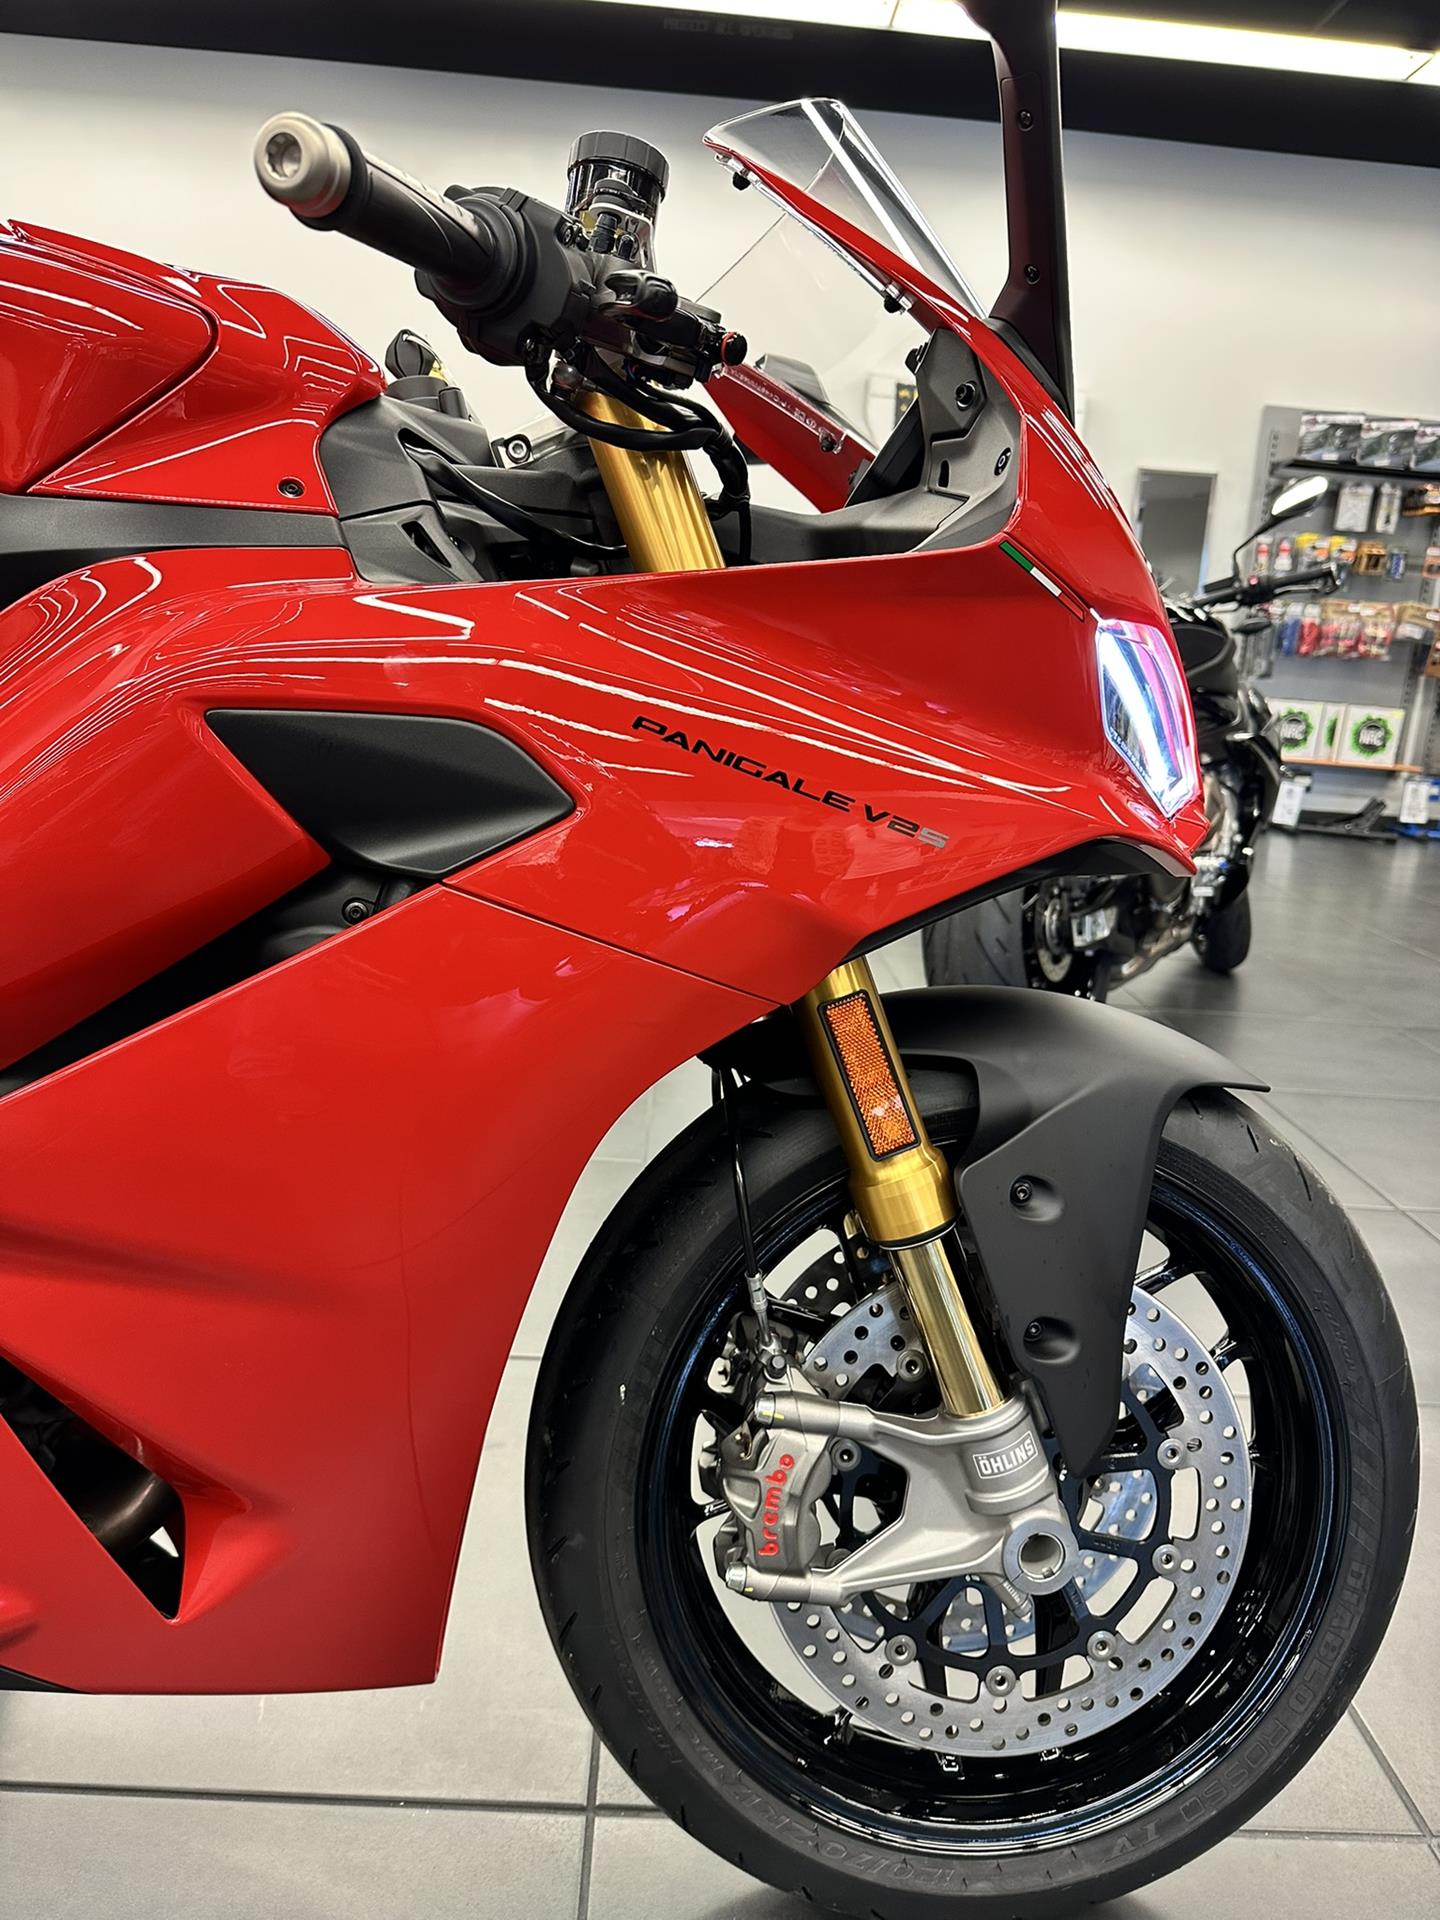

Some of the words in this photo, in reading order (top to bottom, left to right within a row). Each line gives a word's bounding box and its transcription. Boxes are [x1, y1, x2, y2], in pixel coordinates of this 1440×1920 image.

[631, 715, 856, 813] PANIGALE
[758, 1454, 795, 1556] brembo
[978, 1437, 1035, 1475] ÖHLINS
[1284, 1559, 1368, 1716] DIABLO
[1176, 1715, 1291, 1824] ROSSO
[1096, 1819, 1163, 1862] IV
